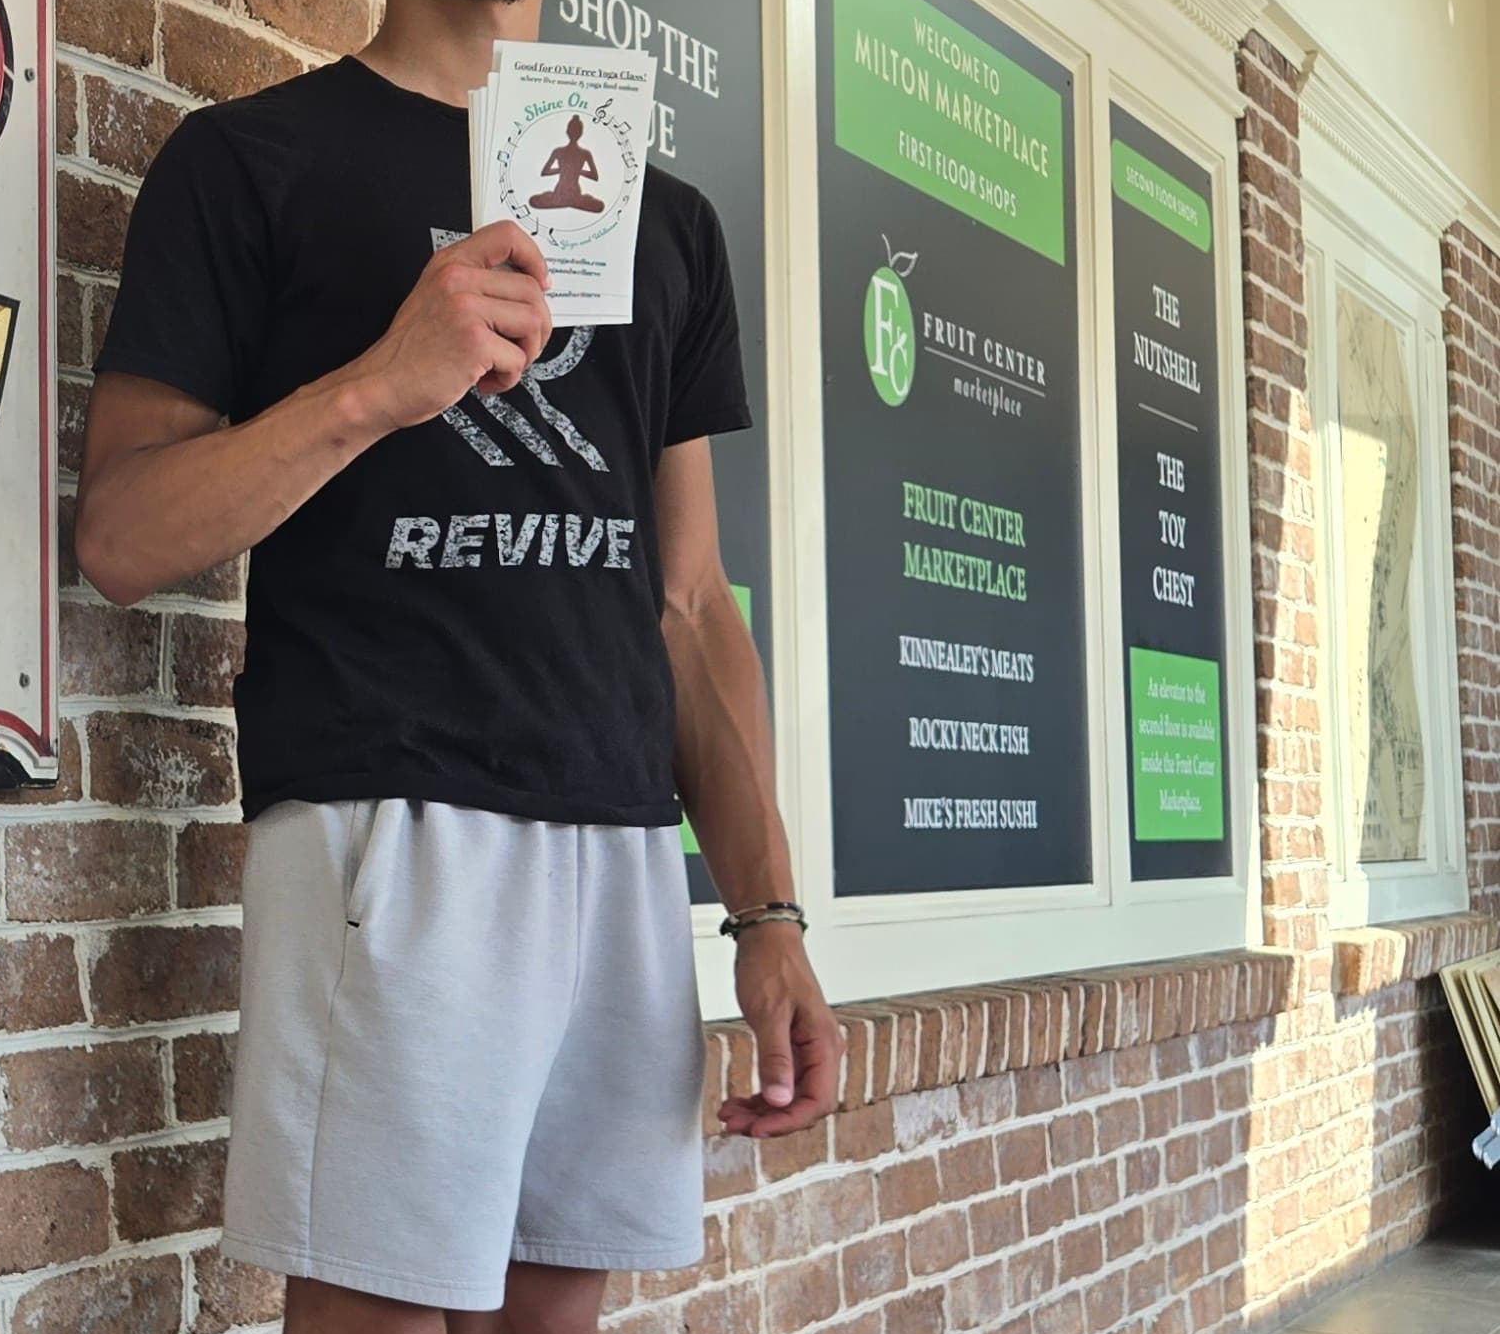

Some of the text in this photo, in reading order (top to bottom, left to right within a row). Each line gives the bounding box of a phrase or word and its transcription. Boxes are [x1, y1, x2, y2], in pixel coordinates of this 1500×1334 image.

[514, 61, 538, 72] Good
[539, 62, 552, 73] for
[658, 19, 719, 99] THE
[914, 16, 1000, 95] WELCOME TO
[524, 91, 589, 122] Shine On
[855, 28, 1049, 178] MILTON MARKETPLACE
[899, 130, 1017, 217] FIRST FLOOR SHOPS
[1152, 284, 1180, 329] THE
[923, 312, 1046, 386] FRUIT CENTER
[1133, 331, 1201, 394] NUTSHELL
[954, 377, 1022, 417] marketplace
[1157, 451, 1185, 493] THE
[902, 481, 1026, 548] FRUIT CENTER
[1158, 510, 1187, 549] TOY
[384, 513, 634, 569] REVIVE
[903, 541, 1027, 602] MARKETPLACE
[1152, 565, 1195, 608] CHEST
[899, 635, 1034, 683] KINNEALEY'S MEATS
[909, 717, 1030, 756] ROCKY NECK FISH
[904, 797, 1038, 829] MIKE'S FRESH SUSHI
